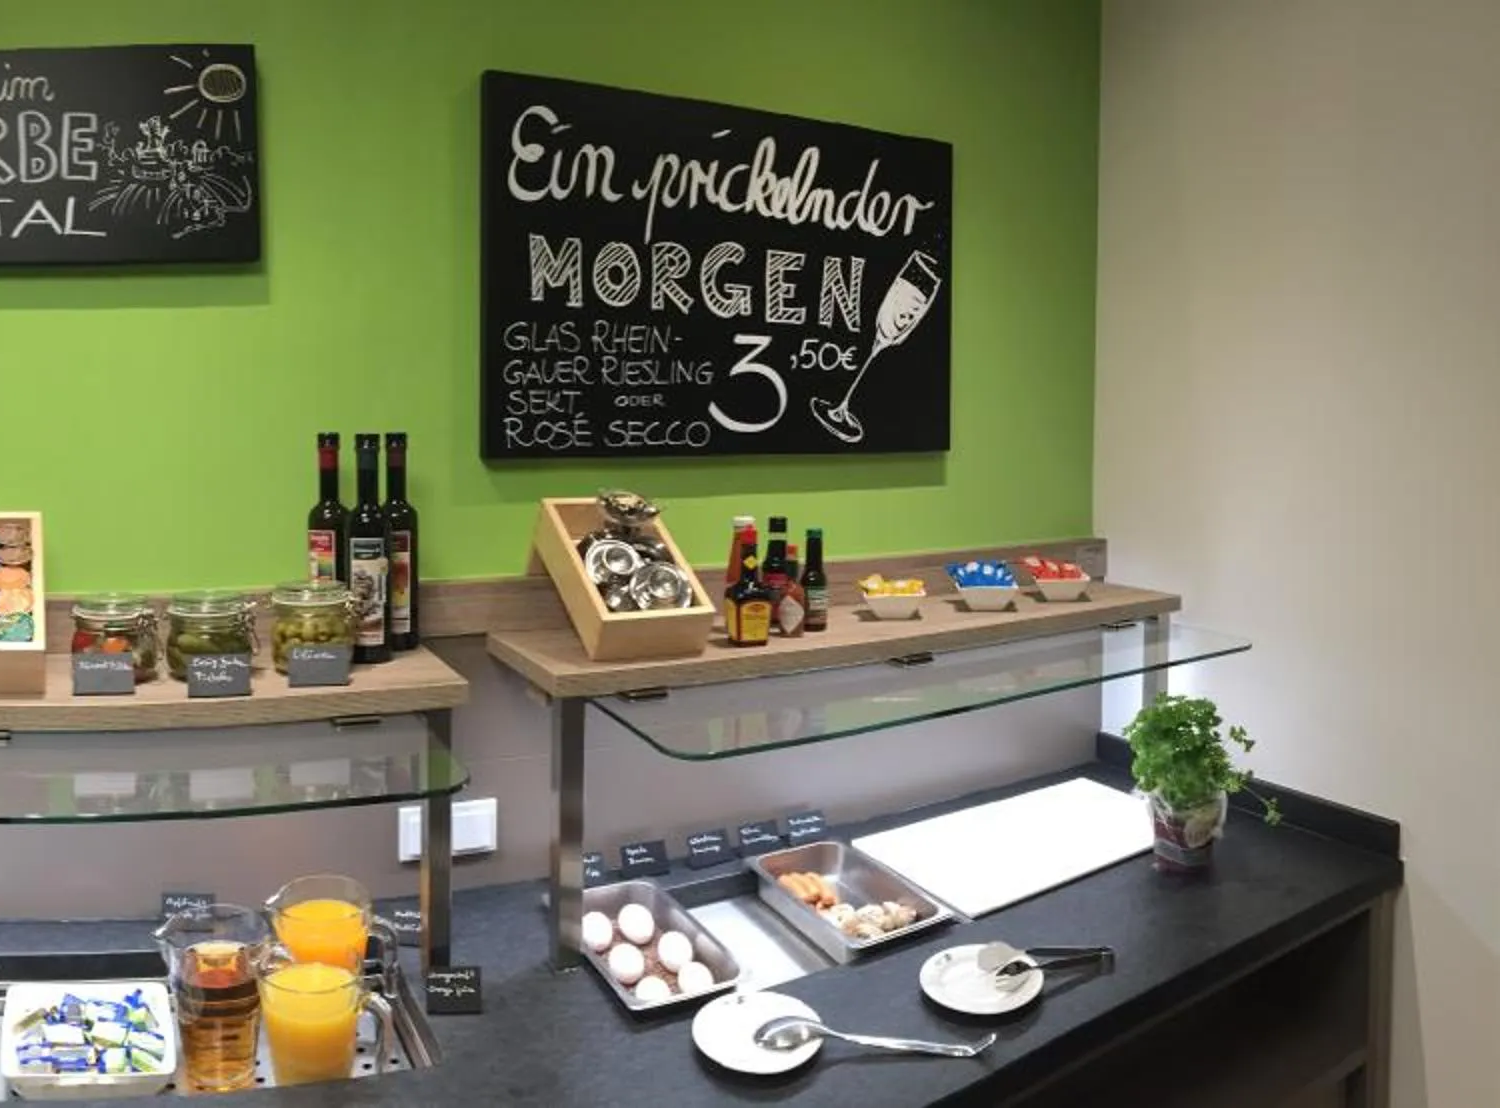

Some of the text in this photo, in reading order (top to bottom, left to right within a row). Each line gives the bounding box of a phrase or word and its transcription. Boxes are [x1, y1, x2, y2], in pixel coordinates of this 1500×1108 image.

[507, 105, 934, 244] Ein prickelnder
[529, 232, 866, 332] MORGEN
[503, 319, 684, 354] GLAS RHEIN-
[502, 355, 714, 386] GAUER RIESLING
[506, 389, 666, 415] SEKT ODER
[503, 411, 711, 450] ROSÉ SECCO
